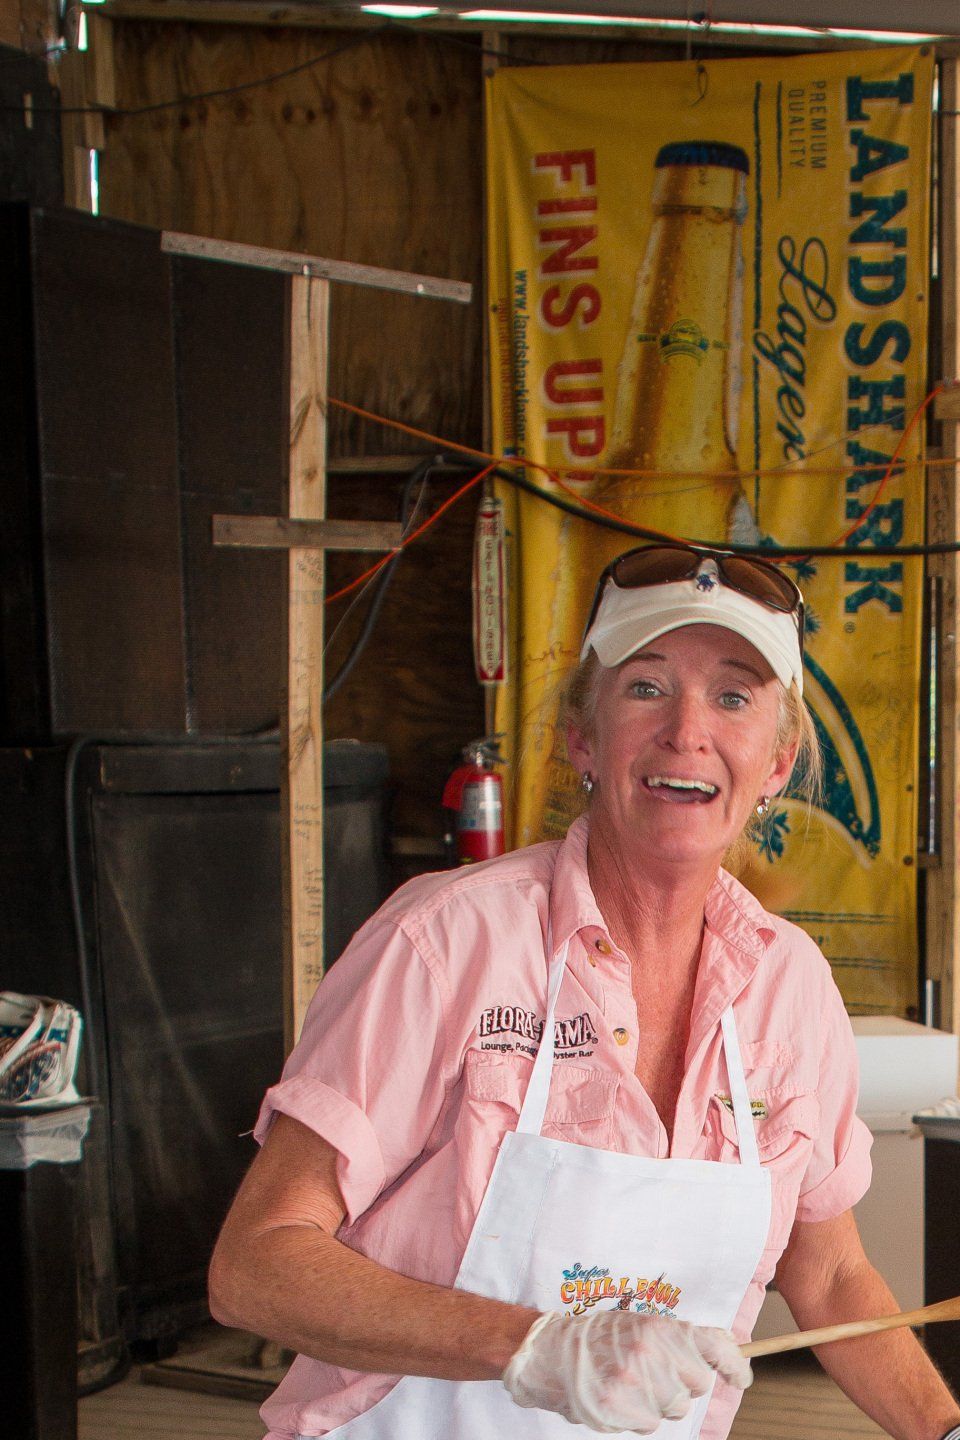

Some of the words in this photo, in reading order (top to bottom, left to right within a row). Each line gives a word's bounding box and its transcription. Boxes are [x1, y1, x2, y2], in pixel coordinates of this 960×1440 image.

[788, 88, 806, 168] QUALITY
[809, 80, 827, 169] PREMIUM
[534, 149, 601, 330] FINS
[753, 236, 837, 465] Lager
[844, 72, 915, 614] LANDSHARK
[481, 1041, 514, 1053] Lounge,
